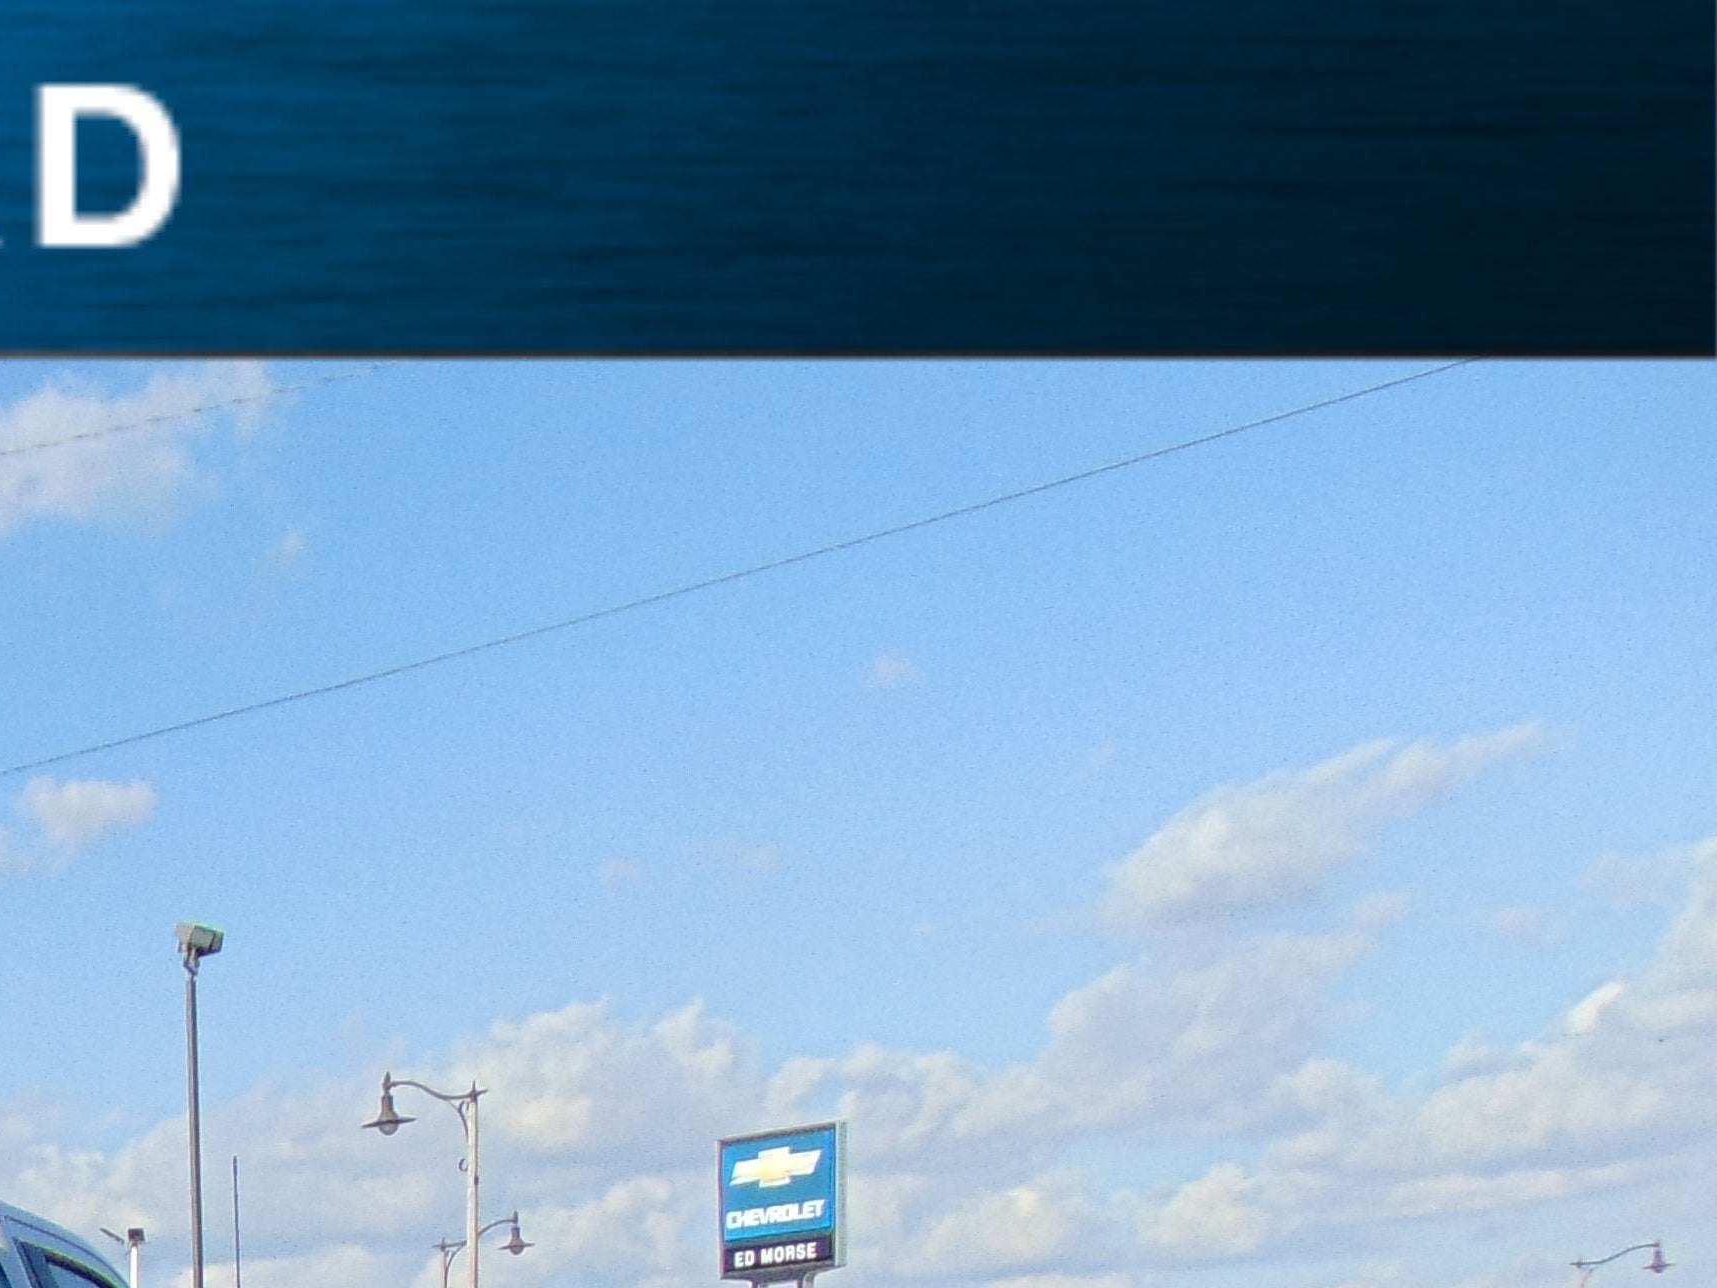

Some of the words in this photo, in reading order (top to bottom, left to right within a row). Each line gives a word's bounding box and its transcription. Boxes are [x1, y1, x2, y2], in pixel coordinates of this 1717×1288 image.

[726, 1199, 826, 1229] CHEVROLET
[733, 1250, 755, 1269] ED
[760, 1241, 818, 1265] MORSE
